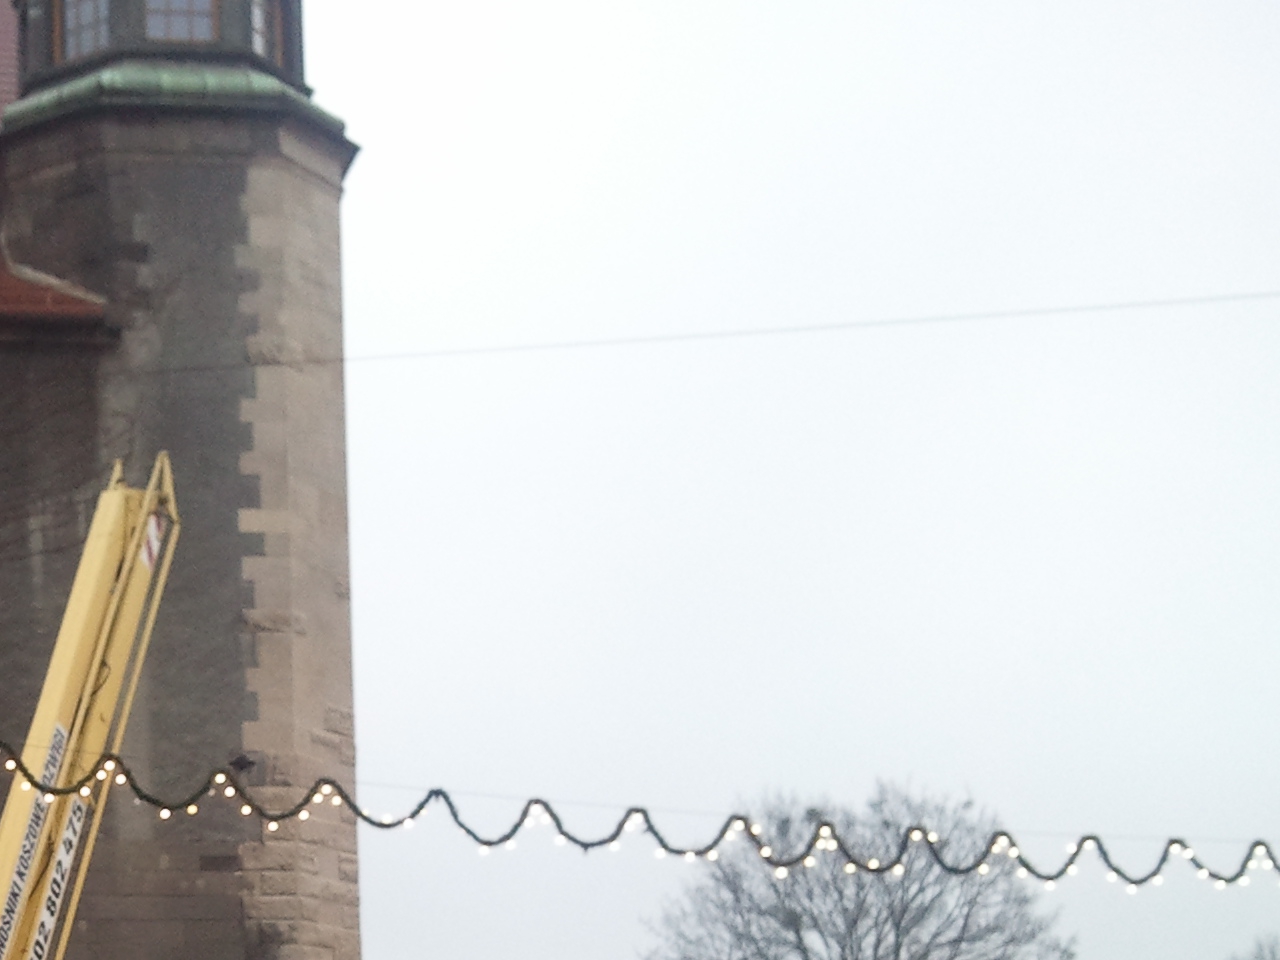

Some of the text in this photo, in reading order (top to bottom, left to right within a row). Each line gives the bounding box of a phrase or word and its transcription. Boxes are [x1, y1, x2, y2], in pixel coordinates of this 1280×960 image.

[15, 797, 46, 882] KOSZOWE
[46, 859, 67, 917] 802
[62, 799, 84, 855] 475
